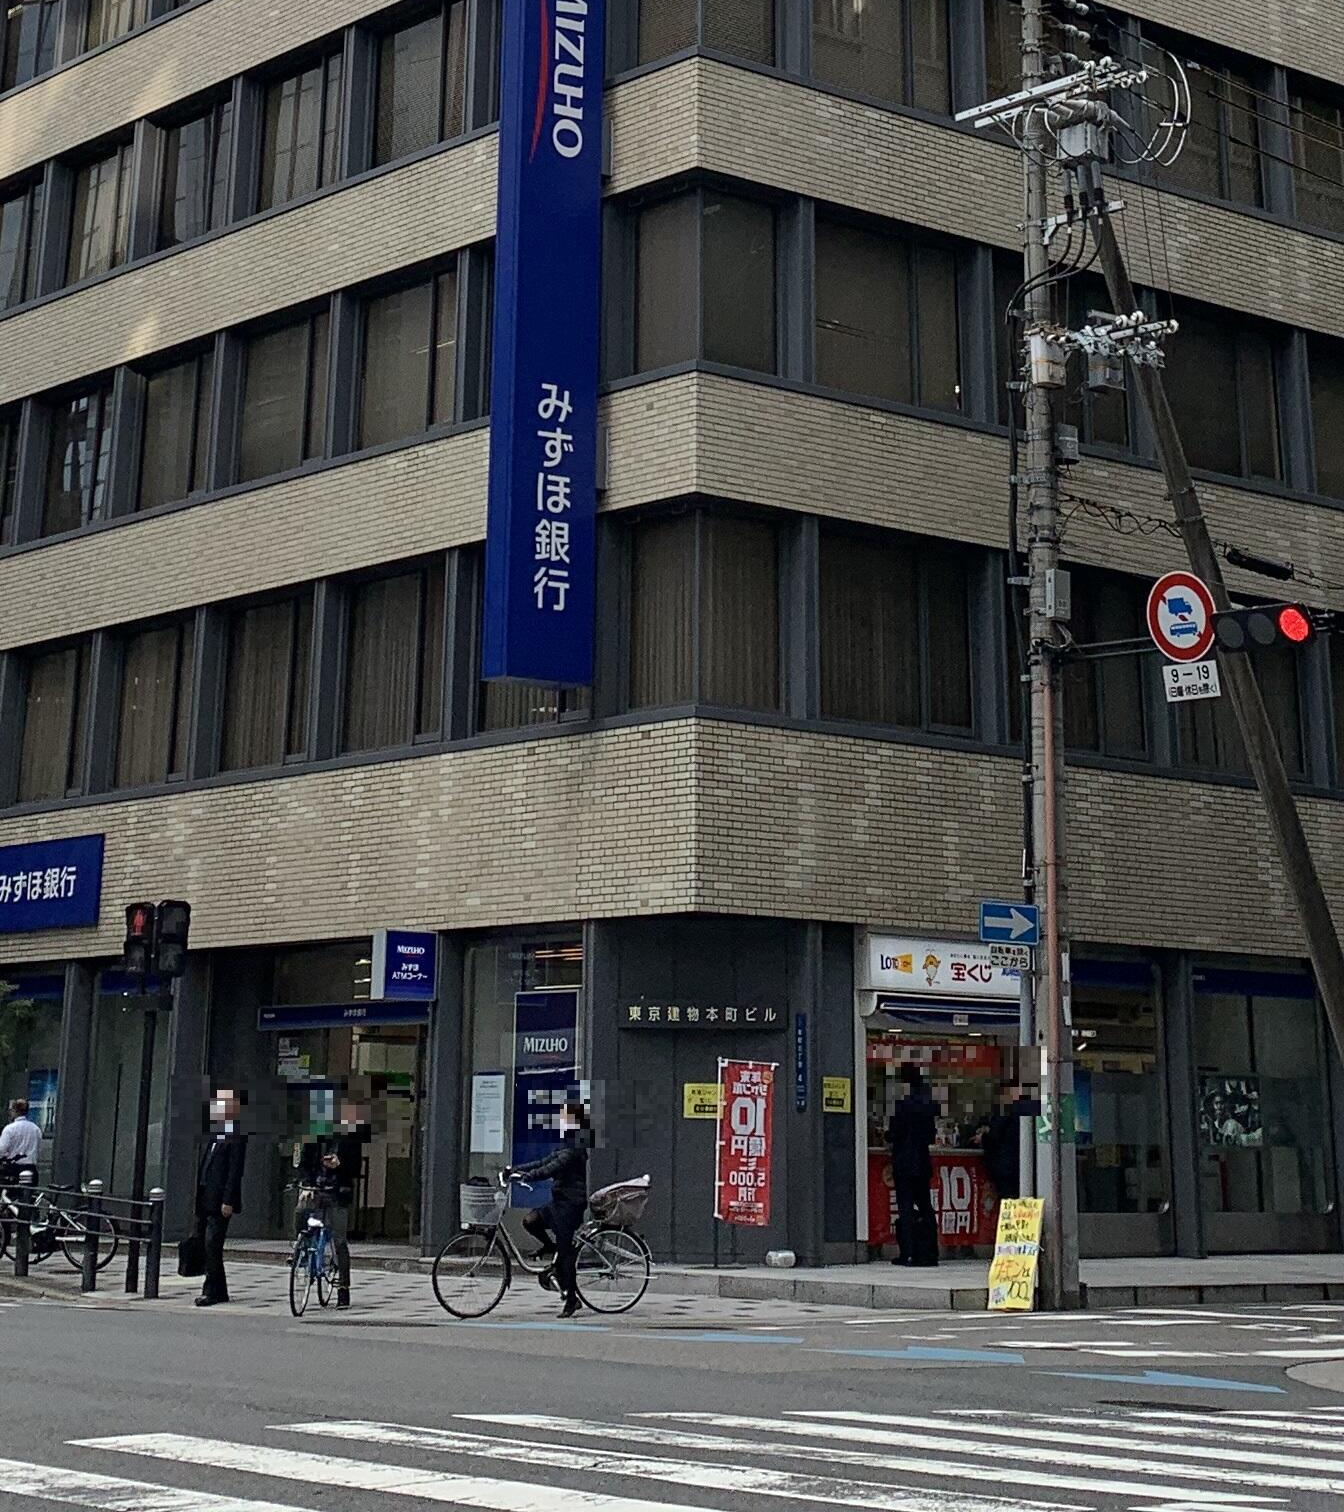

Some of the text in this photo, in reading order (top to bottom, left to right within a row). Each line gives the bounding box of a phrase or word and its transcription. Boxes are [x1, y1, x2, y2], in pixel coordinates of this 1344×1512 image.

[533, 382, 574, 612] みずほ銀行
[397, 944, 426, 955] MIZUHO
[990, 955, 1029, 968] ここから
[391, 971, 429, 980] ATMコーナー
[950, 962, 993, 983] 宝くじ
[628, 1006, 777, 1022] 東京建物本町ビル
[523, 1036, 568, 1053] MIZUHO
[940, 1166, 971, 1210] 10
